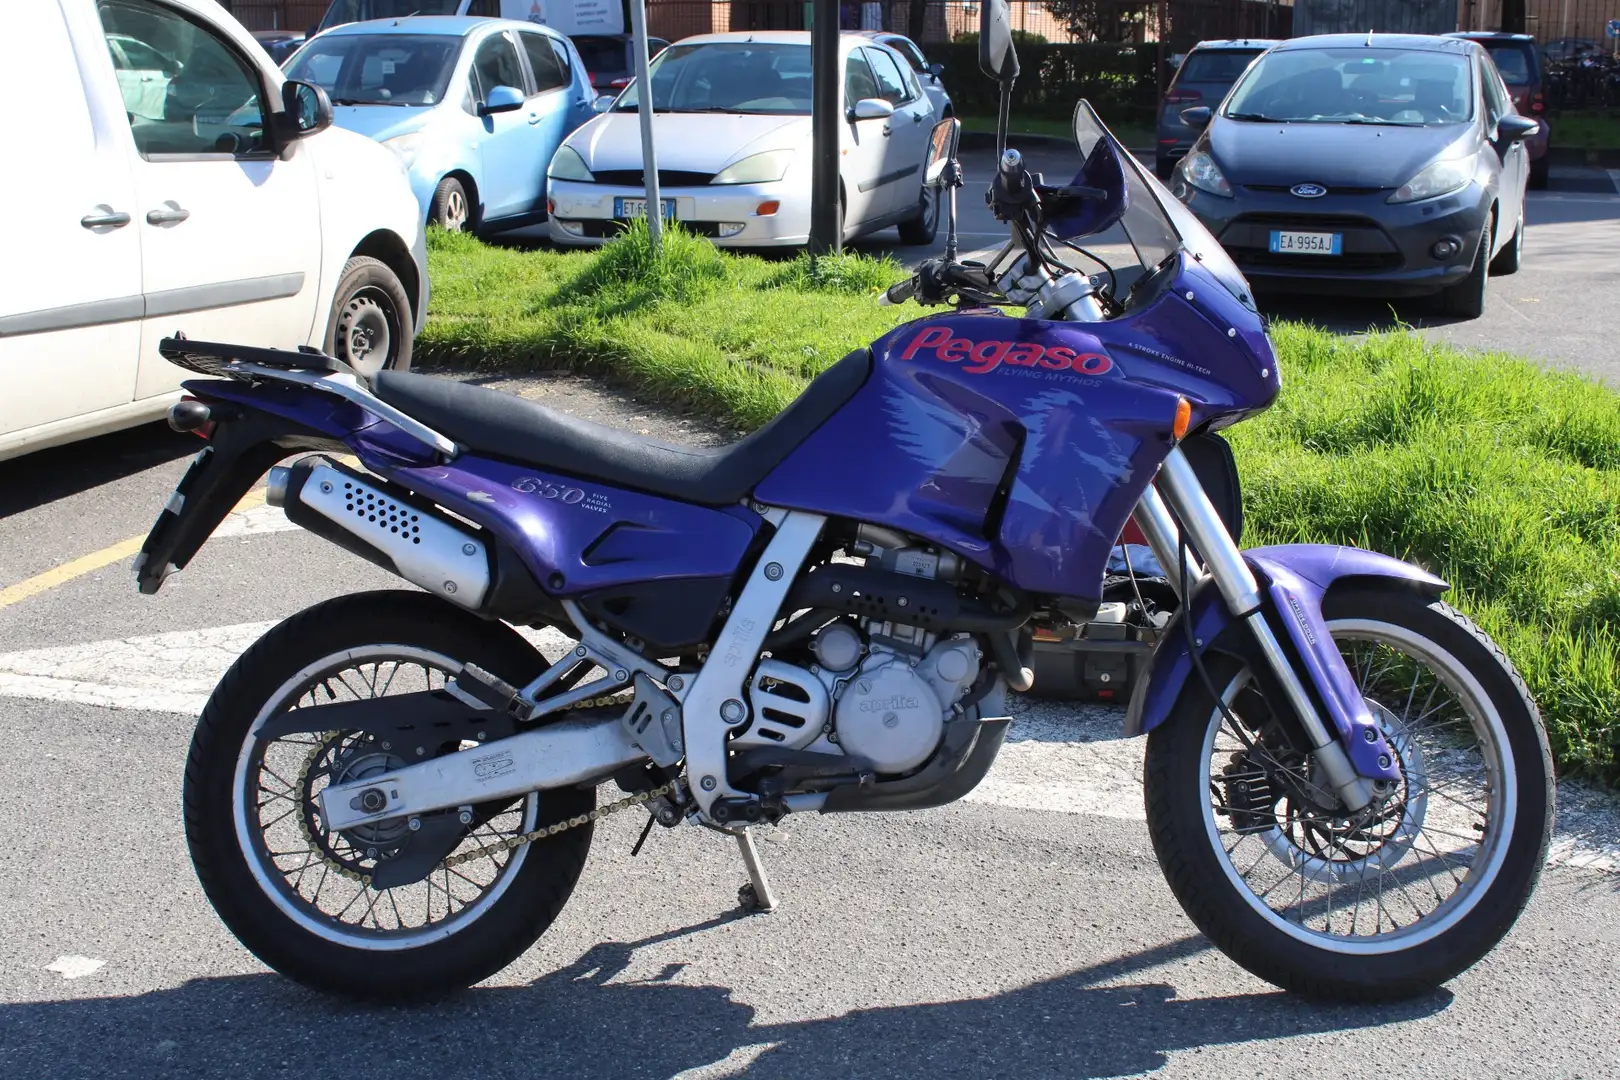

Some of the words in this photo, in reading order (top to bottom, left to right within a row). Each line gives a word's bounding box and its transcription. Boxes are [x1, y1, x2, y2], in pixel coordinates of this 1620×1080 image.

[1298, 186, 1318, 195] Ford
[901, 326, 1113, 376] Pegaso
[1134, 343, 1160, 357] STROKE
[1161, 353, 1186, 366] ENGINE
[997, 367, 1042, 379] FLYING
[1045, 373, 1102, 388] MYTHOS
[511, 477, 585, 504] 650
[592, 493, 608, 501] FIVE
[581, 503, 607, 513] VALVES
[586, 498, 612, 509] RADIAL
[860, 695, 920, 713] aprilia
